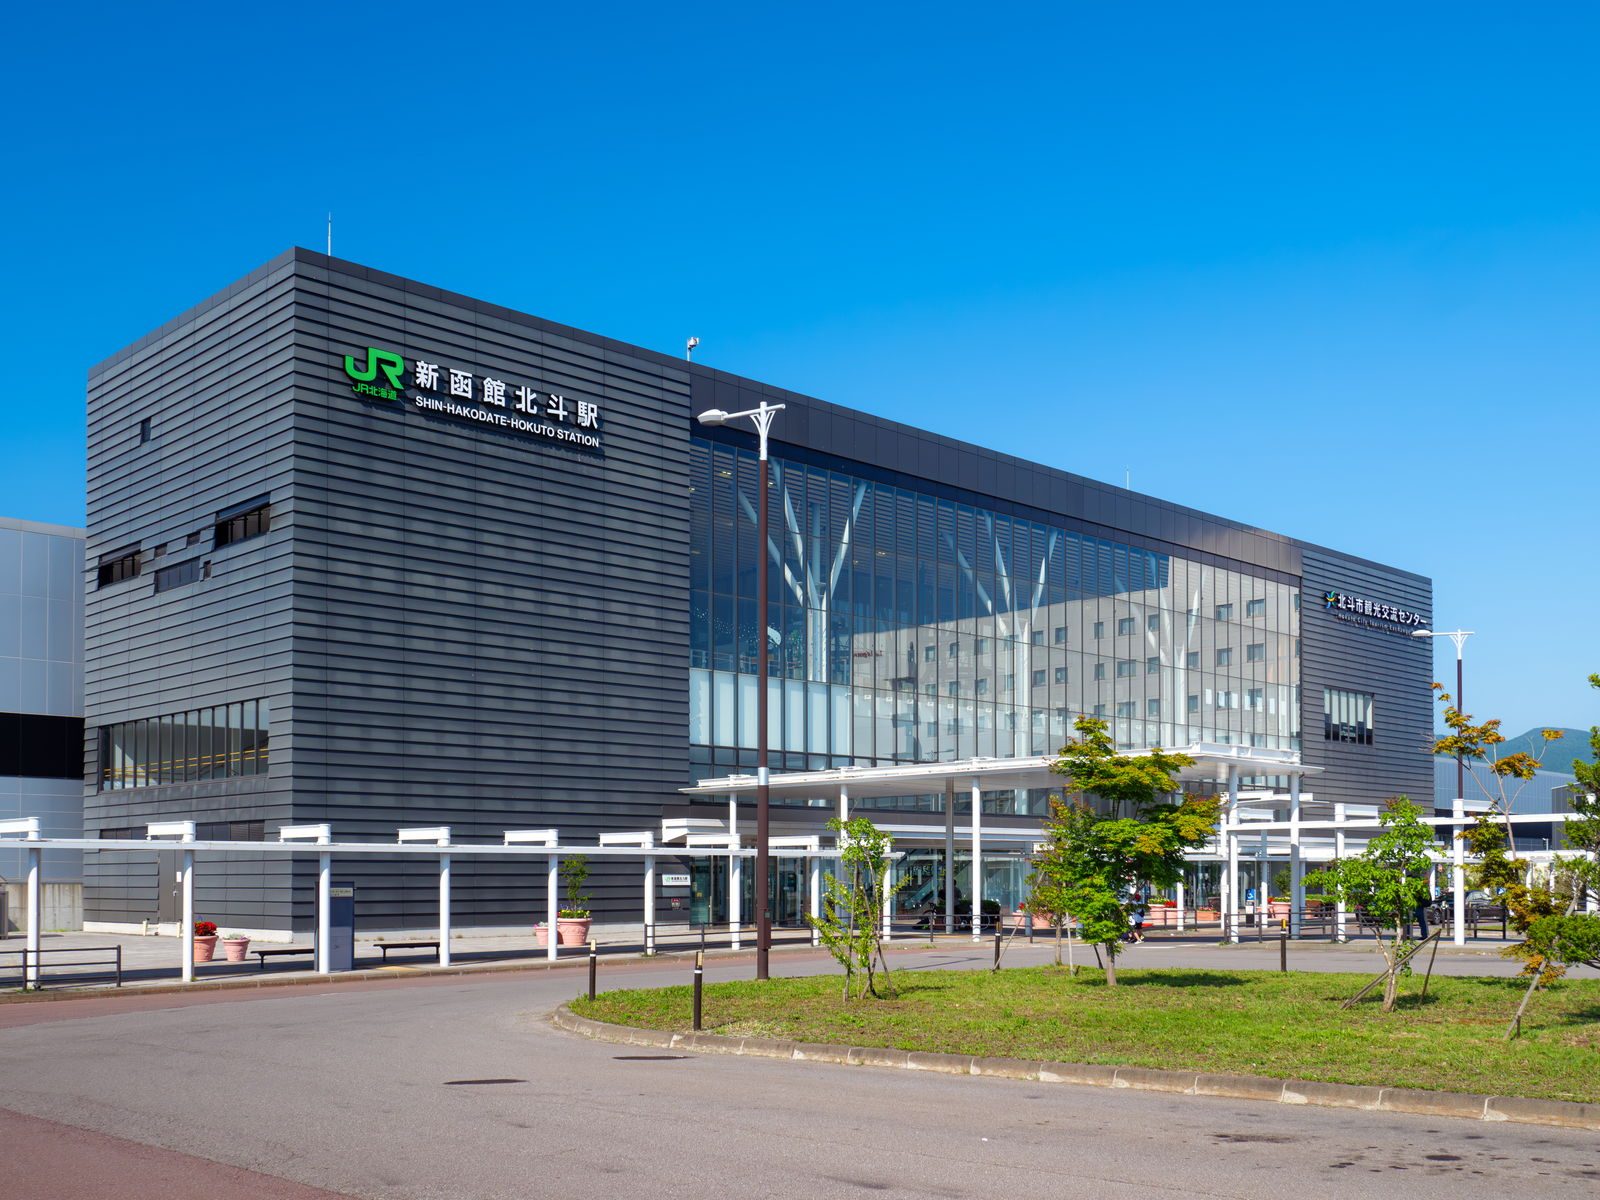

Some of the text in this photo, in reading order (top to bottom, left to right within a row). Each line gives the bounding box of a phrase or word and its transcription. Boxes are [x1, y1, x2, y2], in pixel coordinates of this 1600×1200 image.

[345, 347, 404, 389] JR
[352, 384, 397, 400] JR北海道
[415, 360, 598, 429] 新函館北斗駅
[415, 395, 599, 447] SHIN-HAKODATE-HOKUTO STATION
[1338, 593, 1427, 625] 北斗市観光交流センター
